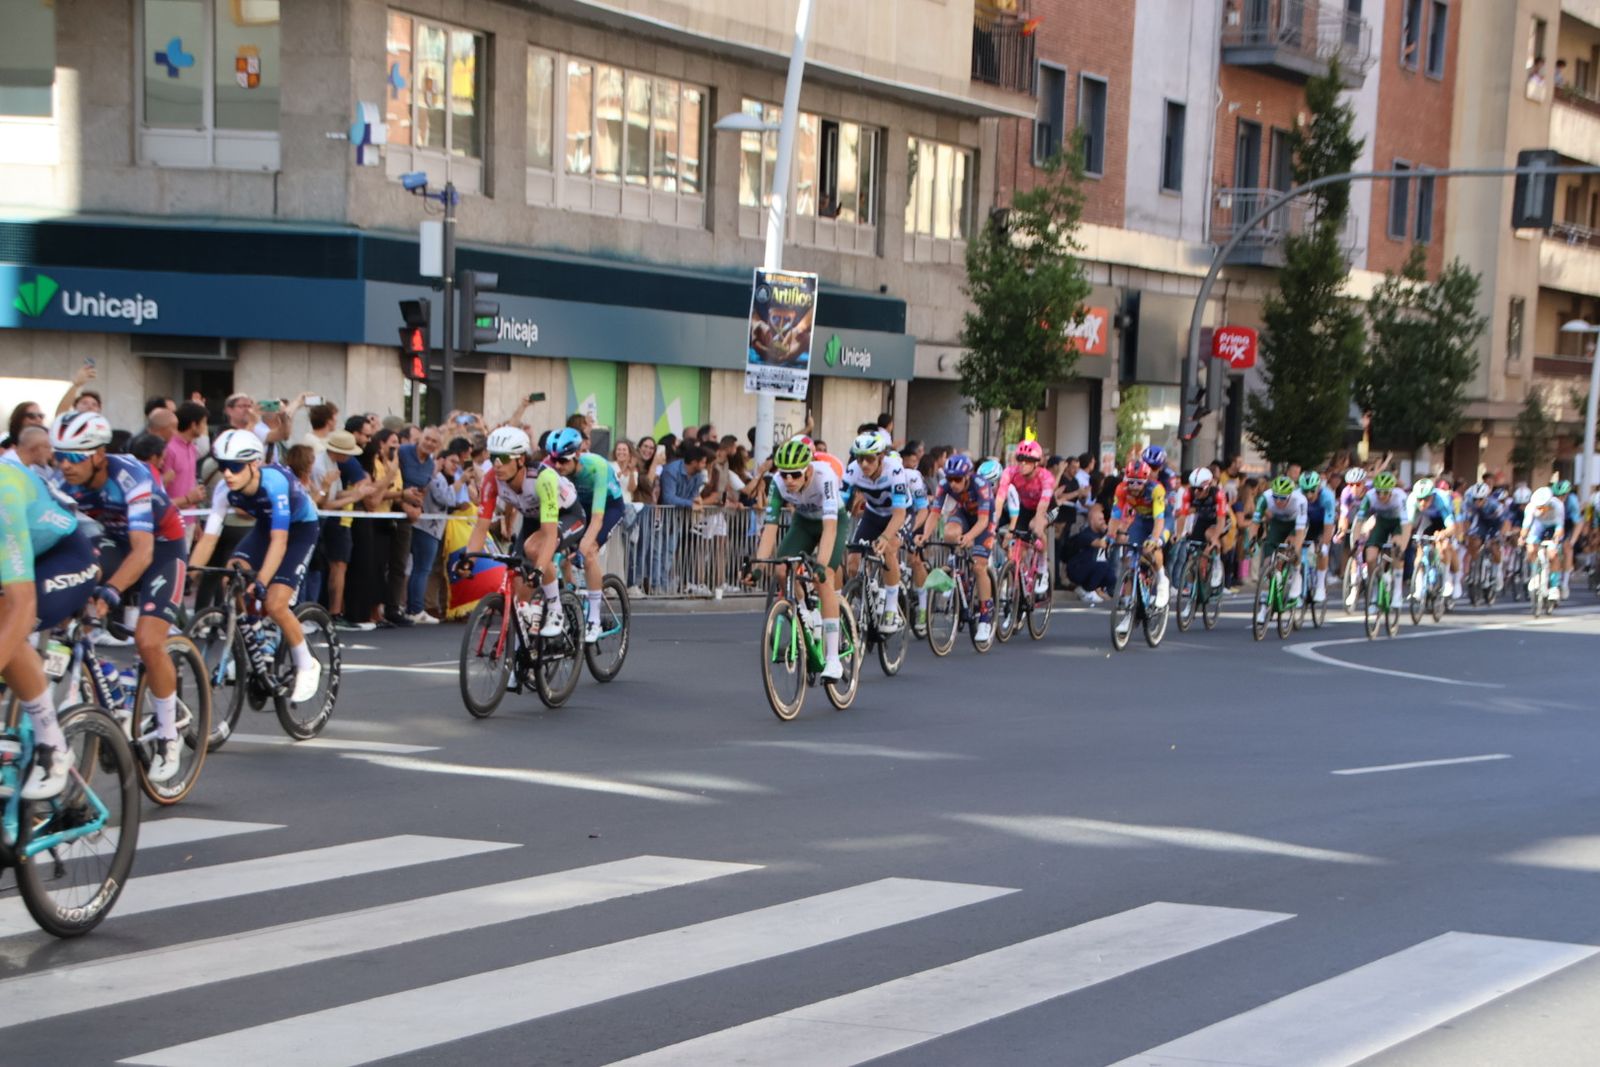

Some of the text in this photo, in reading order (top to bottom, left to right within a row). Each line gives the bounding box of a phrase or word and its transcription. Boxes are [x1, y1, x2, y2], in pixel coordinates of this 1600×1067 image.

[62, 290, 159, 325] Unicaja
[494, 316, 539, 348] Unicaja
[841, 346, 871, 373] Unicaja
[44, 563, 100, 593] ASTANA
